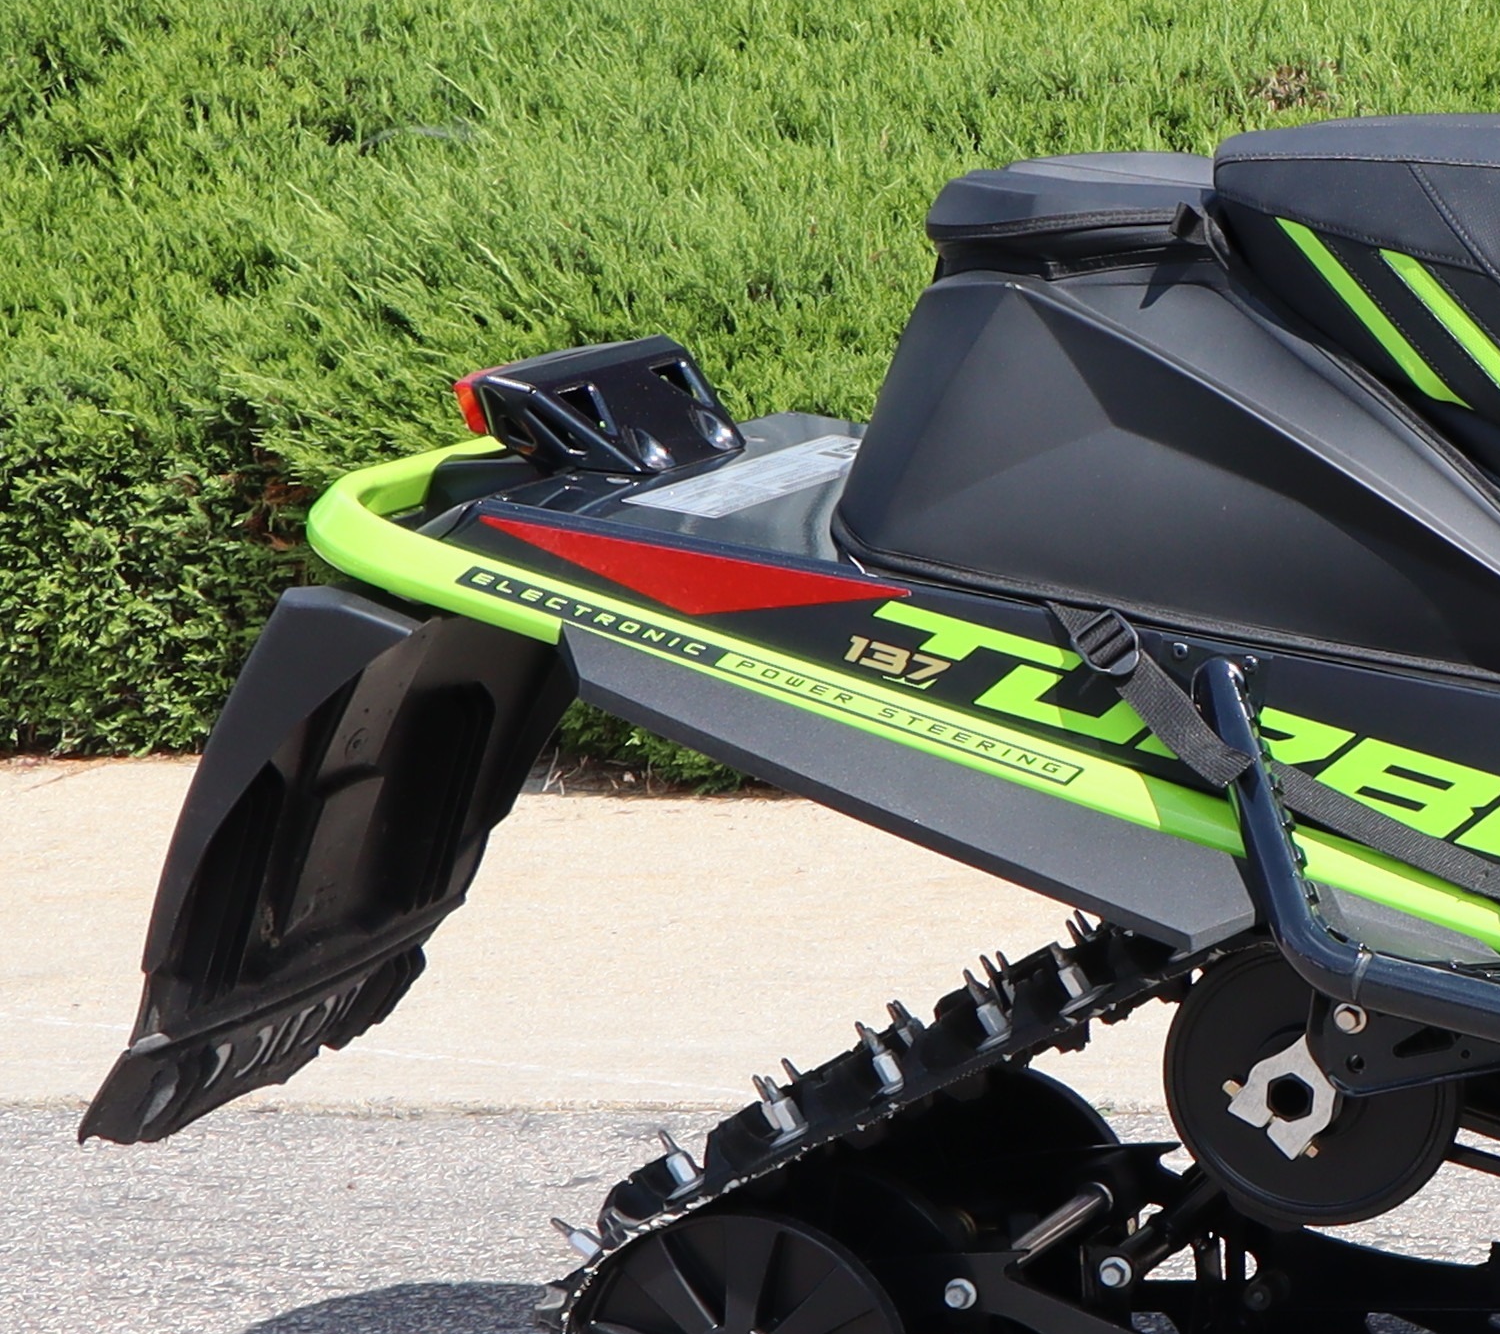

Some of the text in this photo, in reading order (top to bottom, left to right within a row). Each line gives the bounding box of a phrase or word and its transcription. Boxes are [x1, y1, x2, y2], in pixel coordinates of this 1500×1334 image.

[472, 572, 1062, 776] ELECTRONIC POWER STEERING
[843, 635, 952, 681] 137
